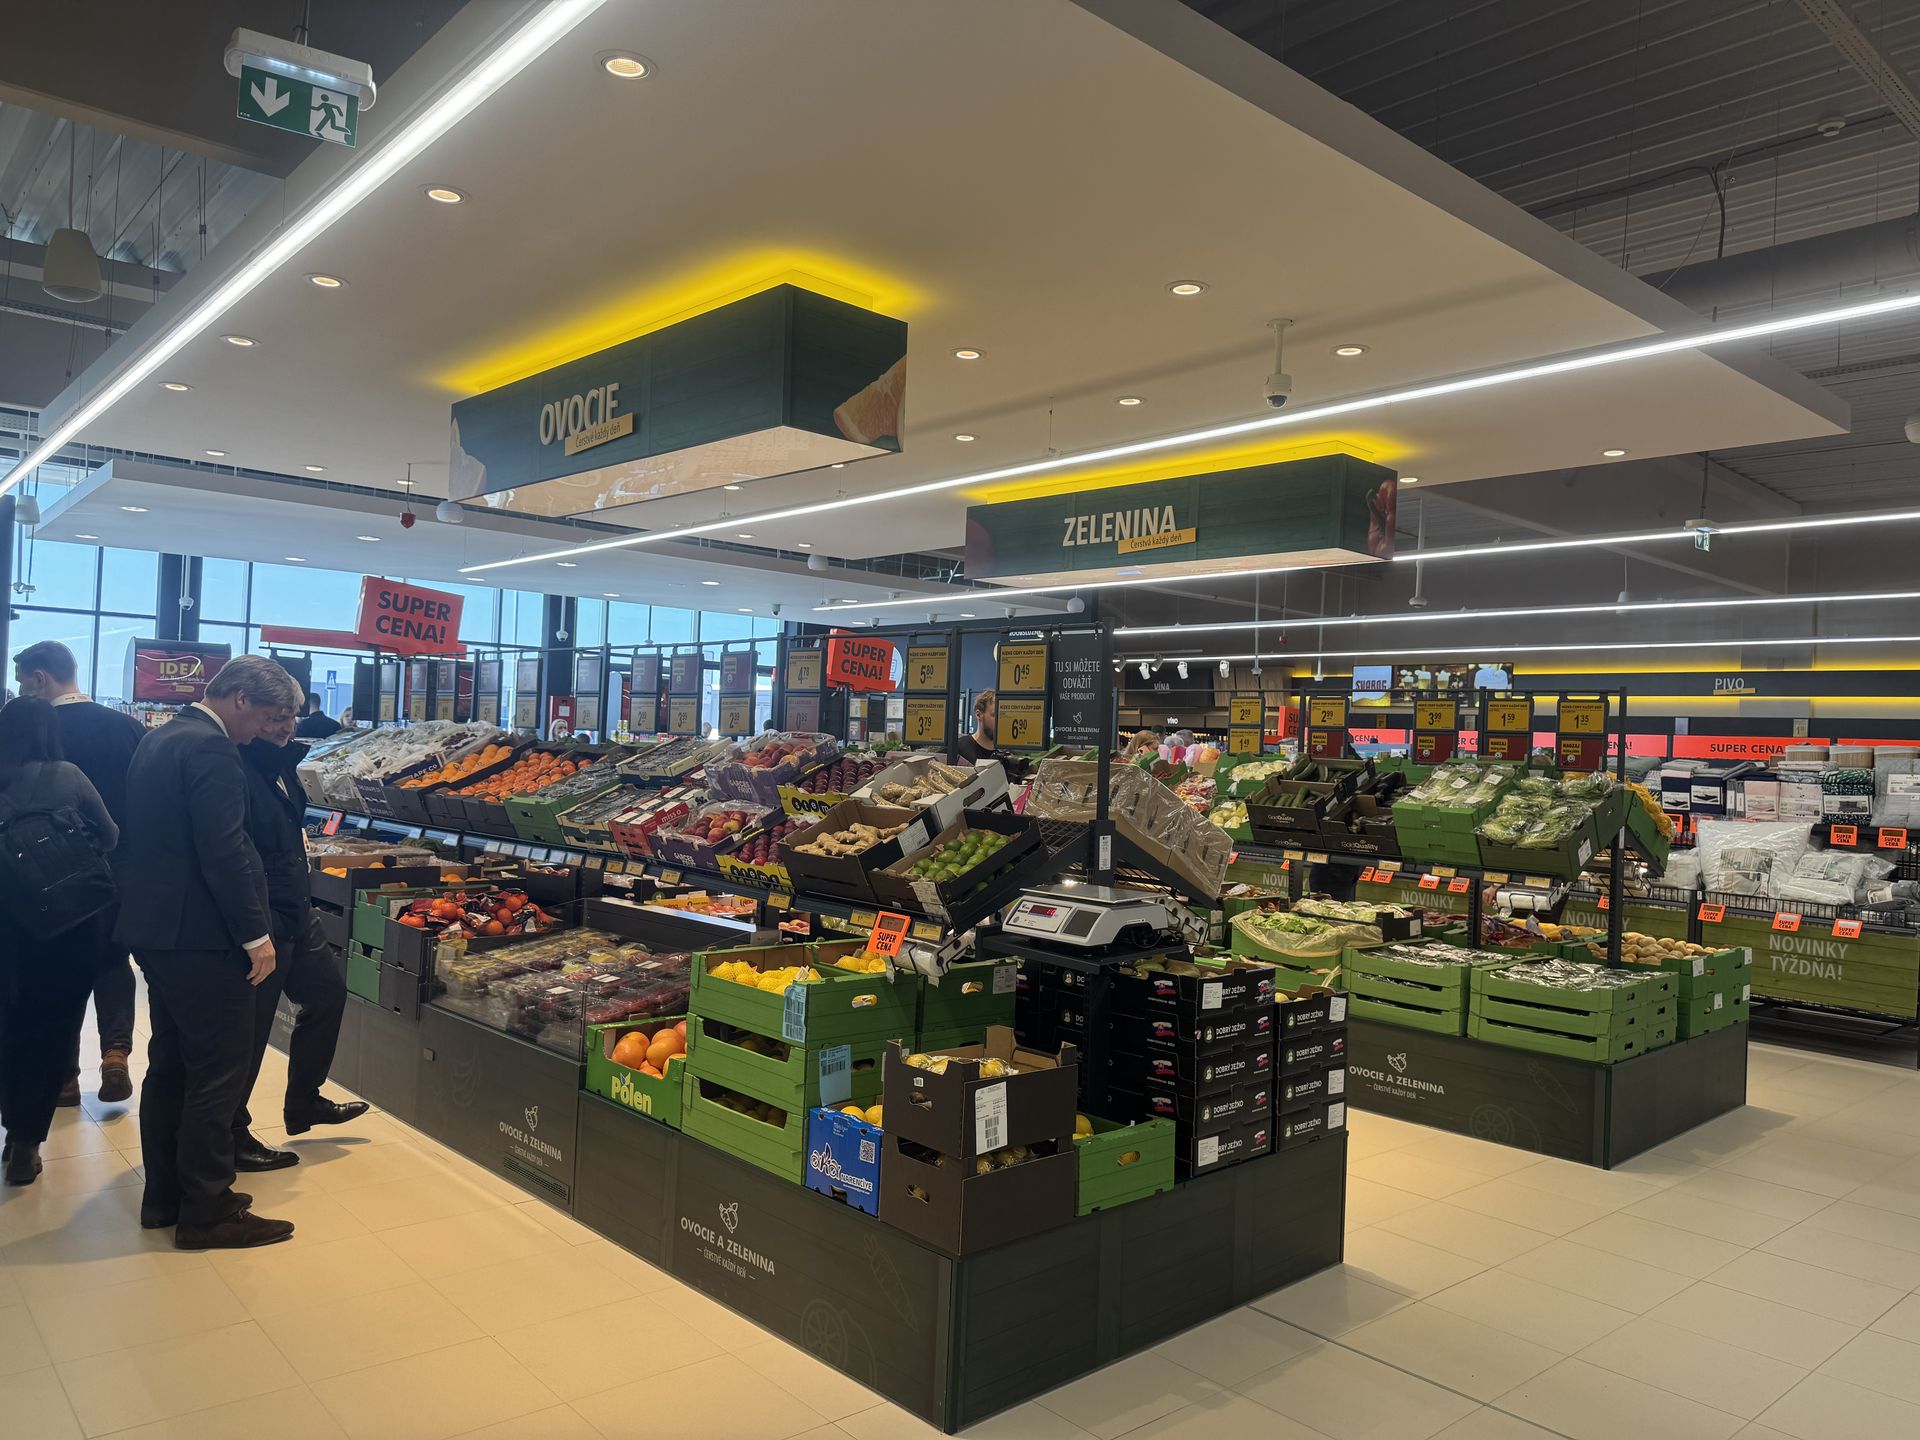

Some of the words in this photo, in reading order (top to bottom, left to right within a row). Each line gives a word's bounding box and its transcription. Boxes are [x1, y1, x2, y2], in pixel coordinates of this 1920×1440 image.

[539, 382, 620, 446] OVOCIE
[1062, 505, 1177, 547] ZELENINA
[377, 590, 451, 622] SUPER
[375, 615, 446, 645] CENA!
[842, 640, 887, 663] SUPER
[159, 661, 205, 676] IDEM
[840, 659, 883, 681] CENA!
[1054, 661, 1064, 673] TU
[1064, 661, 1072, 672] SI
[1073, 658, 1101, 673] MÔŽETE
[1062, 675, 1092, 689] ODVÁŽIŤ
[1153, 681, 1170, 690] VÍNA
[1714, 677, 1745, 690] PIVO
[1710, 743, 1747, 754] SUPER
[1401, 890, 1455, 909] NOVINKY
[1565, 910, 1630, 931] NOVINY
[876, 941, 892, 952] CENA
[877, 932, 897, 944] SUPER
[1769, 935, 1849, 960] NOVINKY
[1770, 953, 1843, 981] TÝŽDŇA!
[1296, 1012, 1310, 1021] DOBRÝ
[1215, 1025, 1231, 1036] DOBRÝ
[1296, 1048, 1309, 1057] DOBRÝ
[1215, 1063, 1230, 1074] DOBRÝ
[1295, 1083, 1309, 1093] DOBRÝ
[1349, 1065, 1384, 1081] OVOCIE
[1386, 1074, 1394, 1083] A
[1396, 1075, 1445, 1095] ZELENINA
[611, 1075, 652, 1115] Polen
[1213, 1102, 1229, 1114] DOBRÝ
[1294, 1122, 1308, 1132] DOBRÝ
[499, 1121, 522, 1141] OVOCIE
[523, 1133, 529, 1145] A
[529, 1136, 562, 1162] ZELENINA
[680, 1217, 715, 1244] OVOCIE
[716, 1235, 725, 1249] A
[726, 1239, 775, 1275] ZELENINA
[703, 1246, 722, 1266] ČERSTVÉ
[722, 1258, 736, 1273] KAŽDÝ
[736, 1265, 746, 1278] DEŇ
